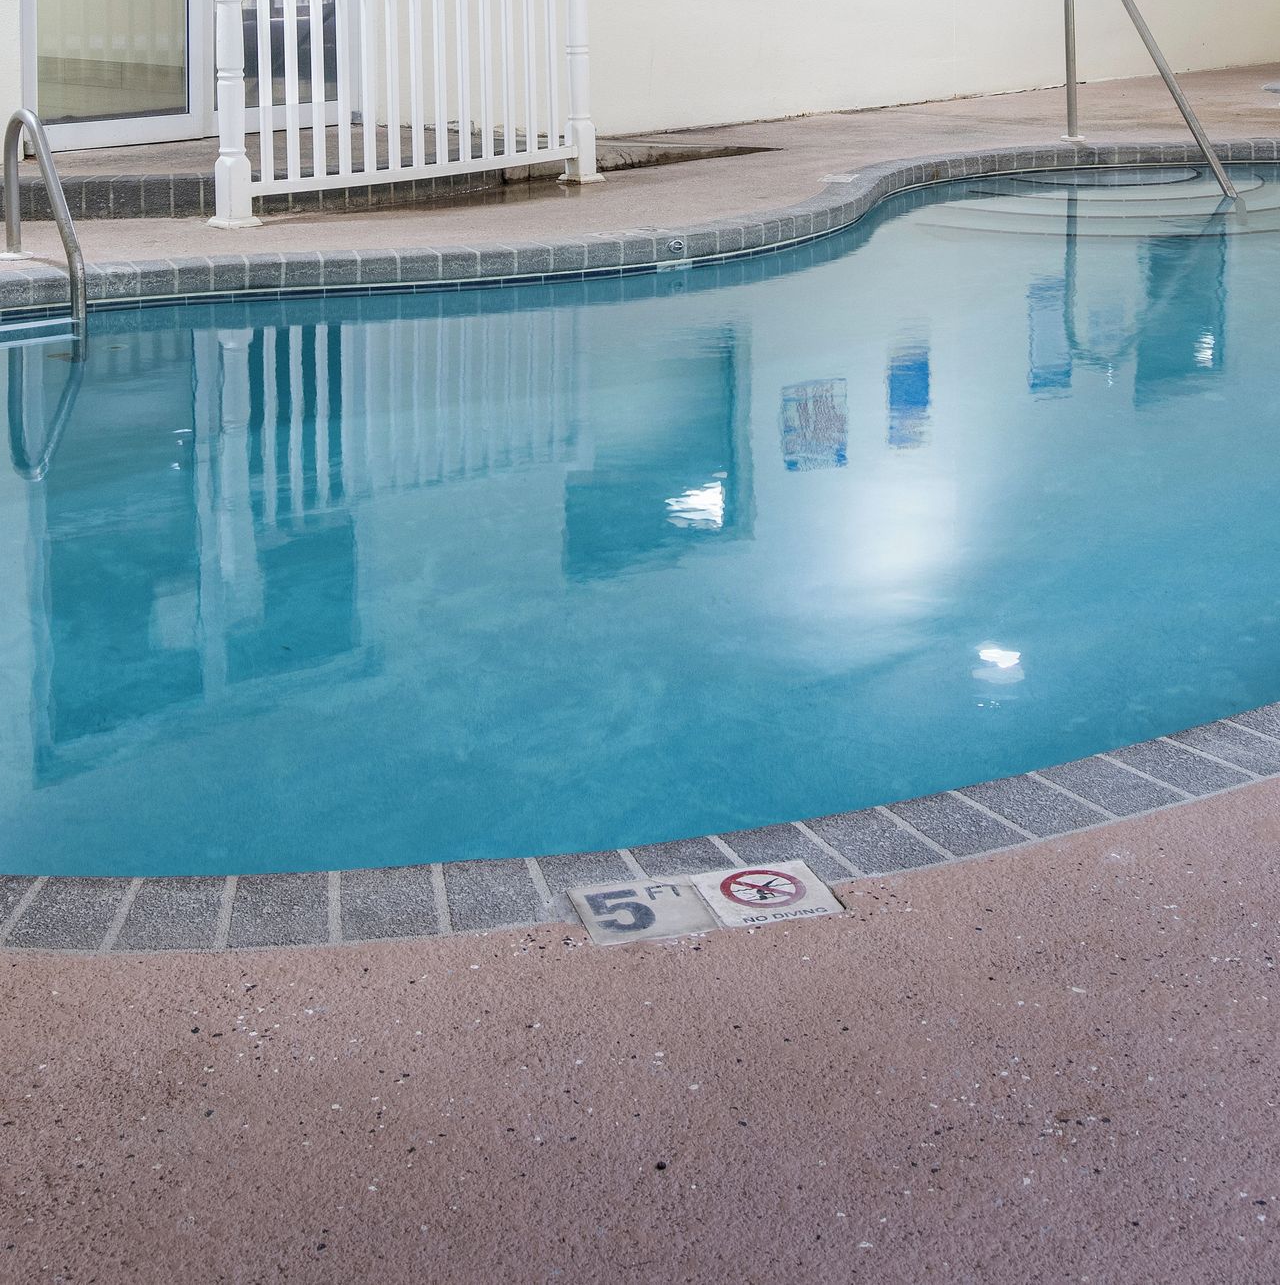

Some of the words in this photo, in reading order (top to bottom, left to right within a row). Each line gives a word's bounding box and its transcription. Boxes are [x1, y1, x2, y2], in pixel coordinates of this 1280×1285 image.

[584, 888, 656, 933] 5
[644, 883, 681, 900] FT
[742, 915, 768, 924] NO
[770, 906, 829, 921] DIVING
